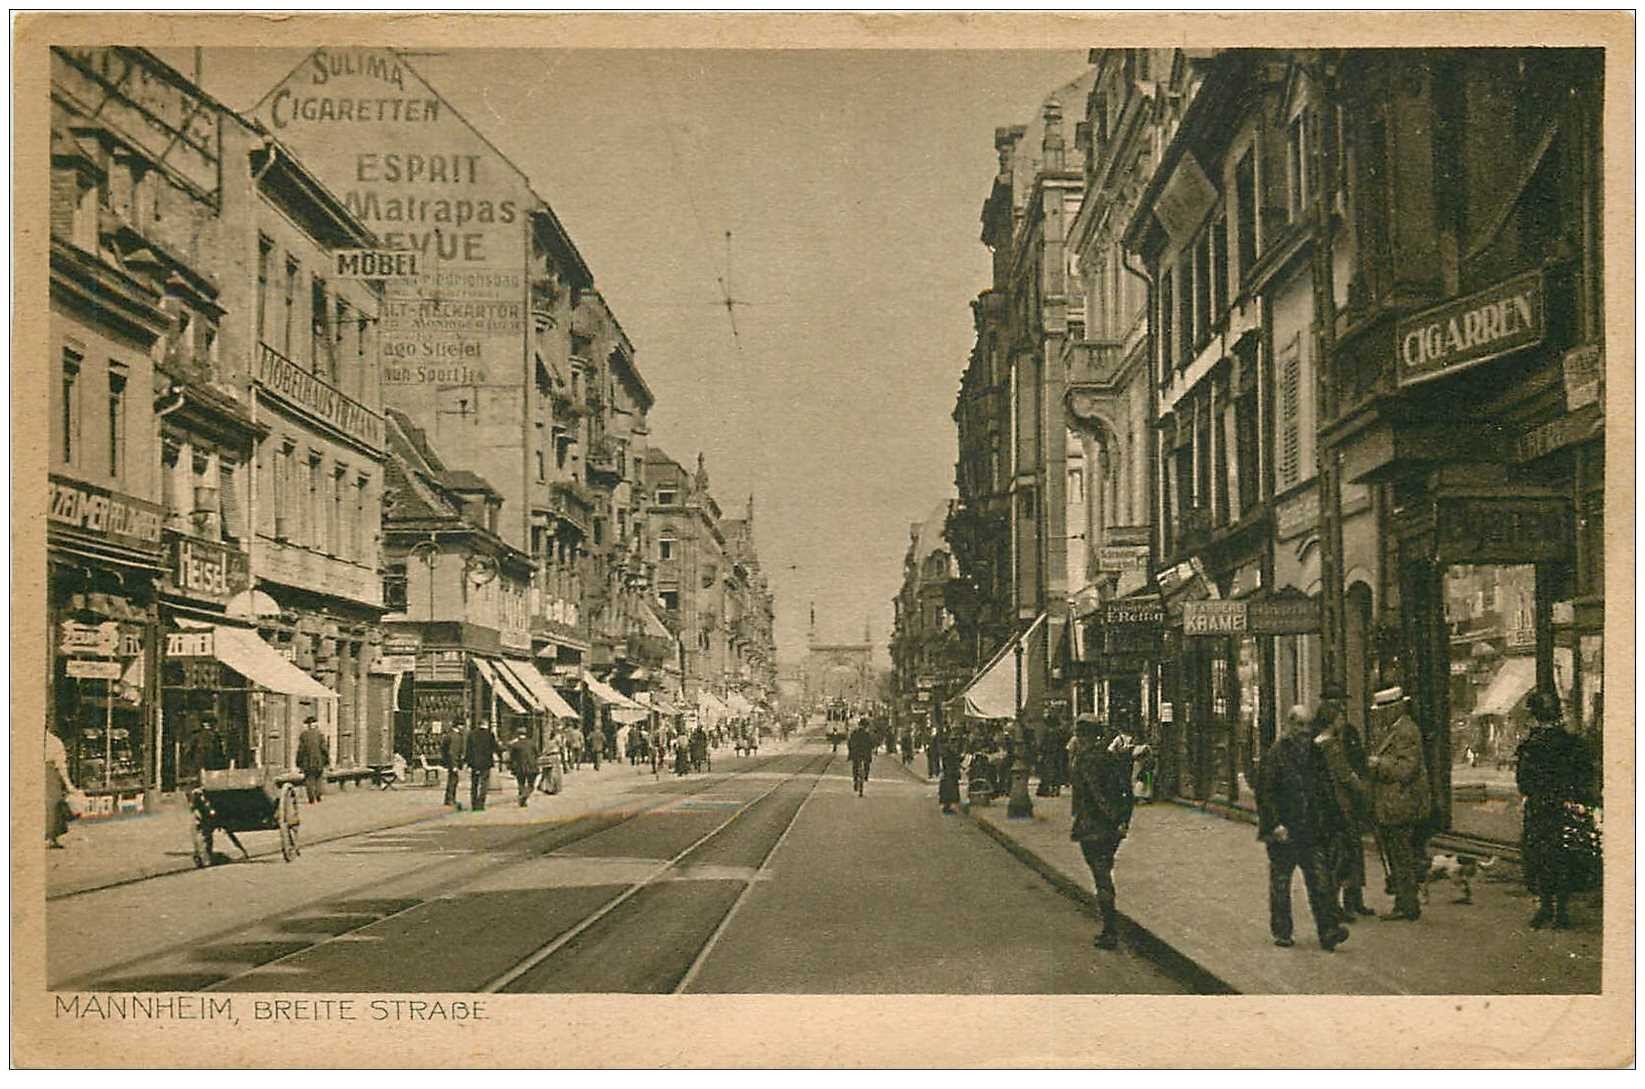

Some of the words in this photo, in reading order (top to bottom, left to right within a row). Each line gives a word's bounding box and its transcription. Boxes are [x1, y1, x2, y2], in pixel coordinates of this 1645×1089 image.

[311, 51, 404, 91] SULIMA
[271, 90, 439, 128] CIGARETTEN
[356, 154, 482, 184] ESPRIT
[382, 231, 486, 261] EVUE
[1403, 292, 1534, 366] CIGARREN
